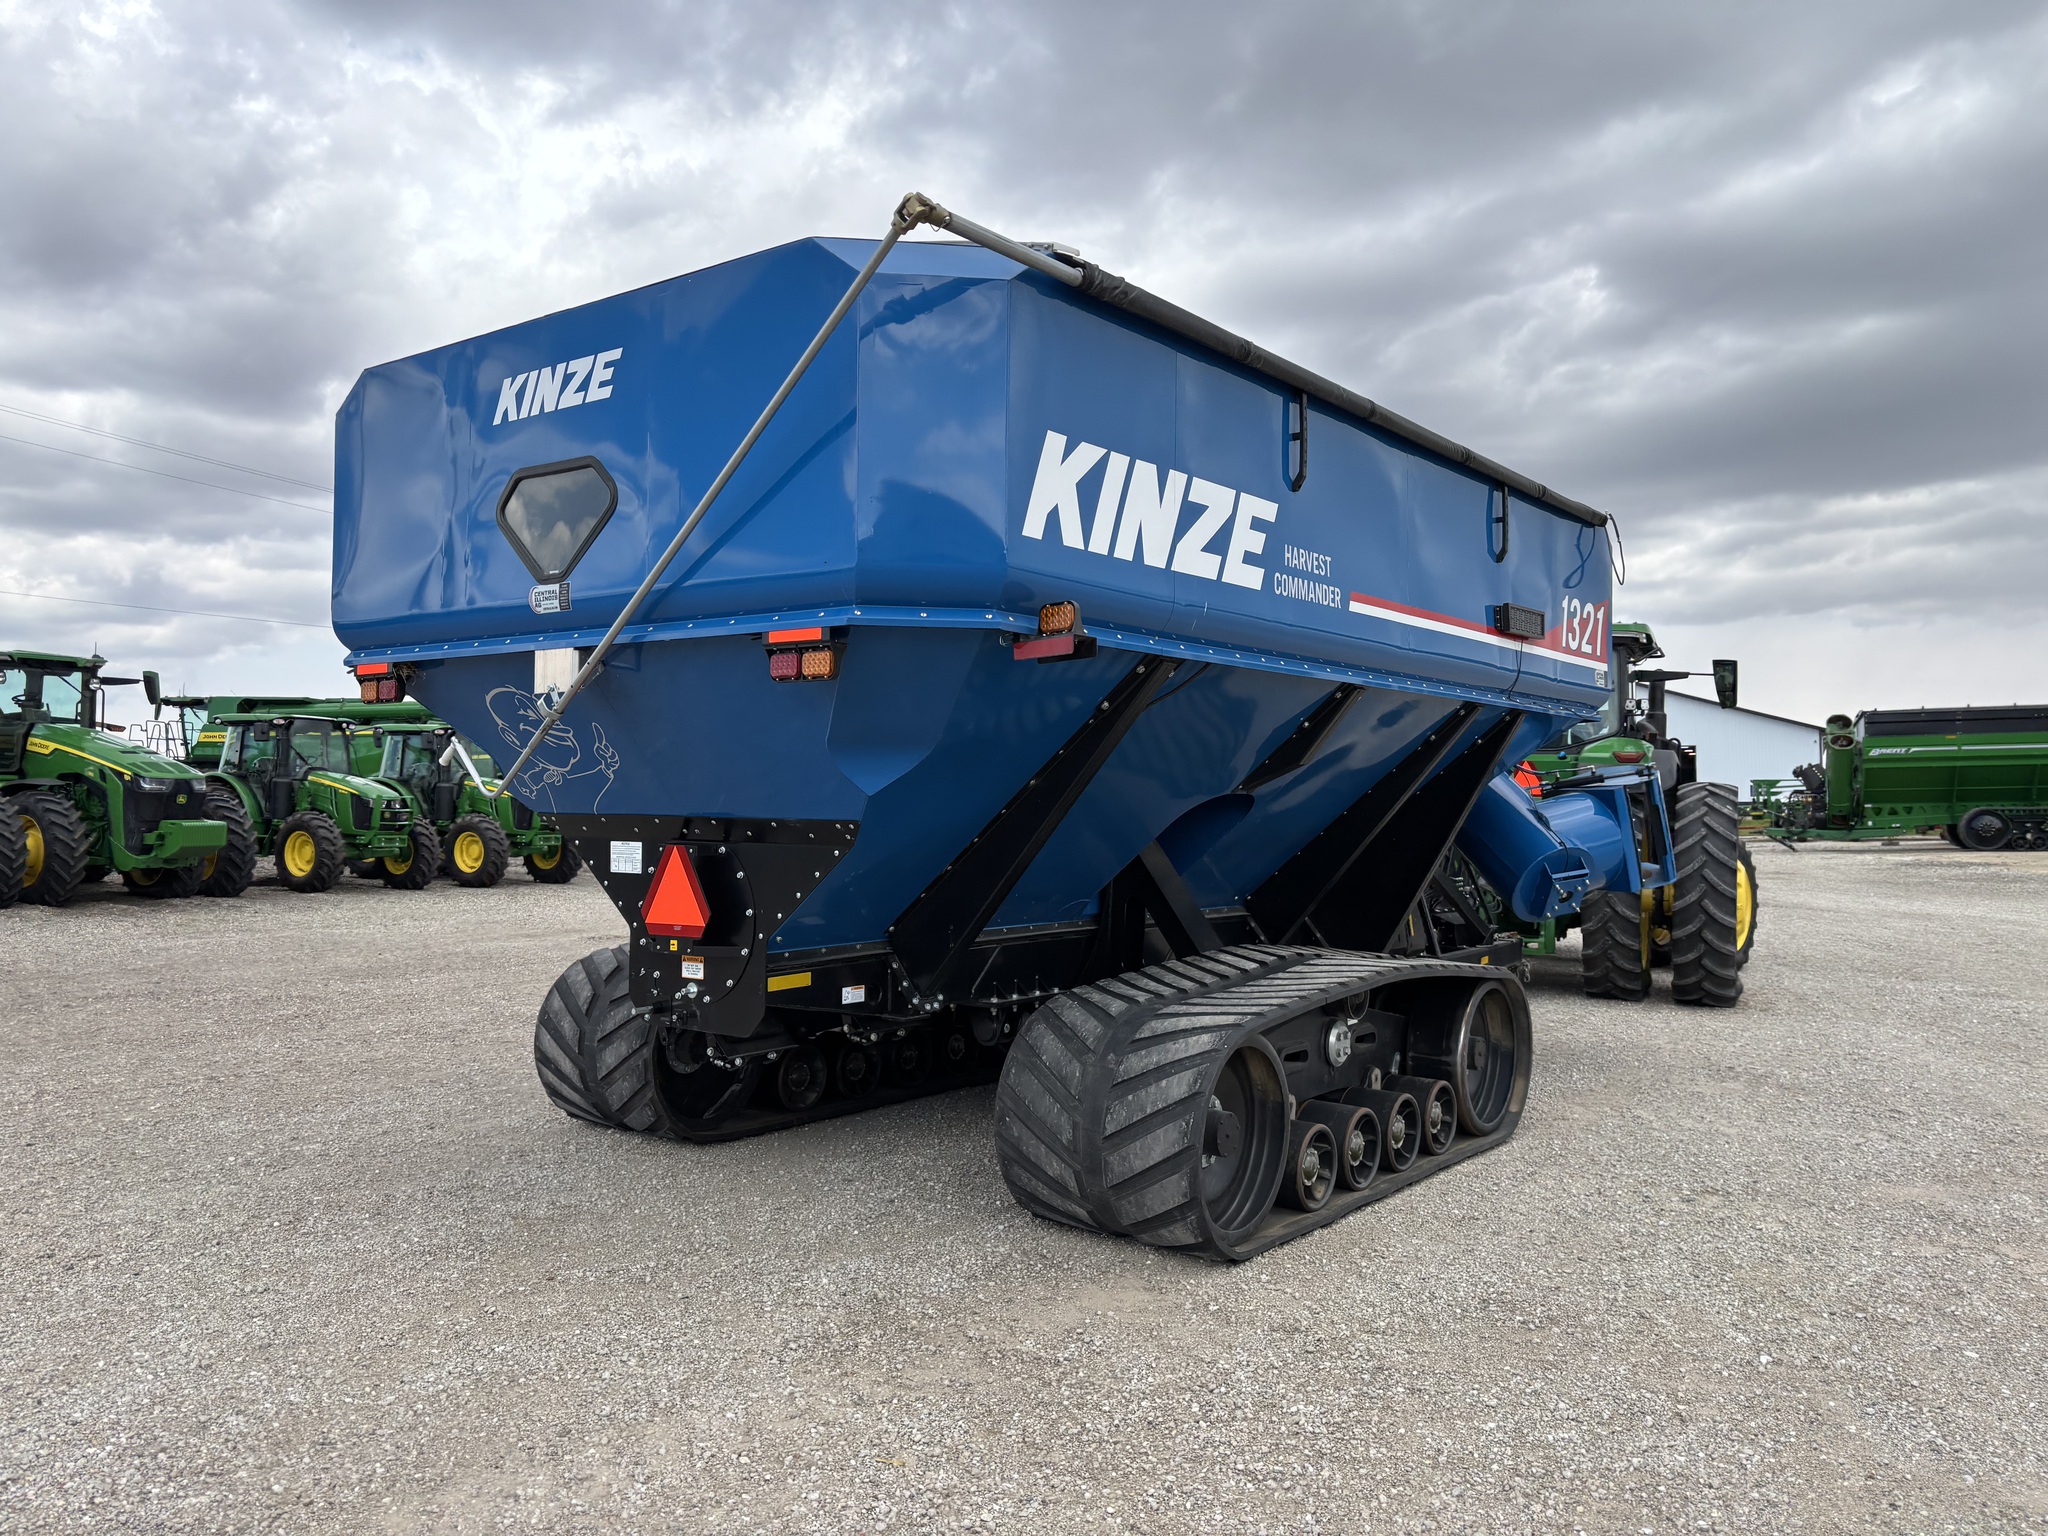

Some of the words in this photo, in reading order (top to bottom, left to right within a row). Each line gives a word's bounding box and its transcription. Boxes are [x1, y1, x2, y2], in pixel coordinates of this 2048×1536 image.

[493, 347, 623, 426] KINZE
[1021, 429, 1279, 591] KINZE
[1284, 544, 1332, 577] HARVEST
[534, 589, 558, 597] CENTRAL
[1274, 572, 1342, 609] COMMANDER
[1562, 595, 1605, 657] 1321
[28, 740, 39, 748] JOHN
[1868, 747, 1907, 756] BRENT
